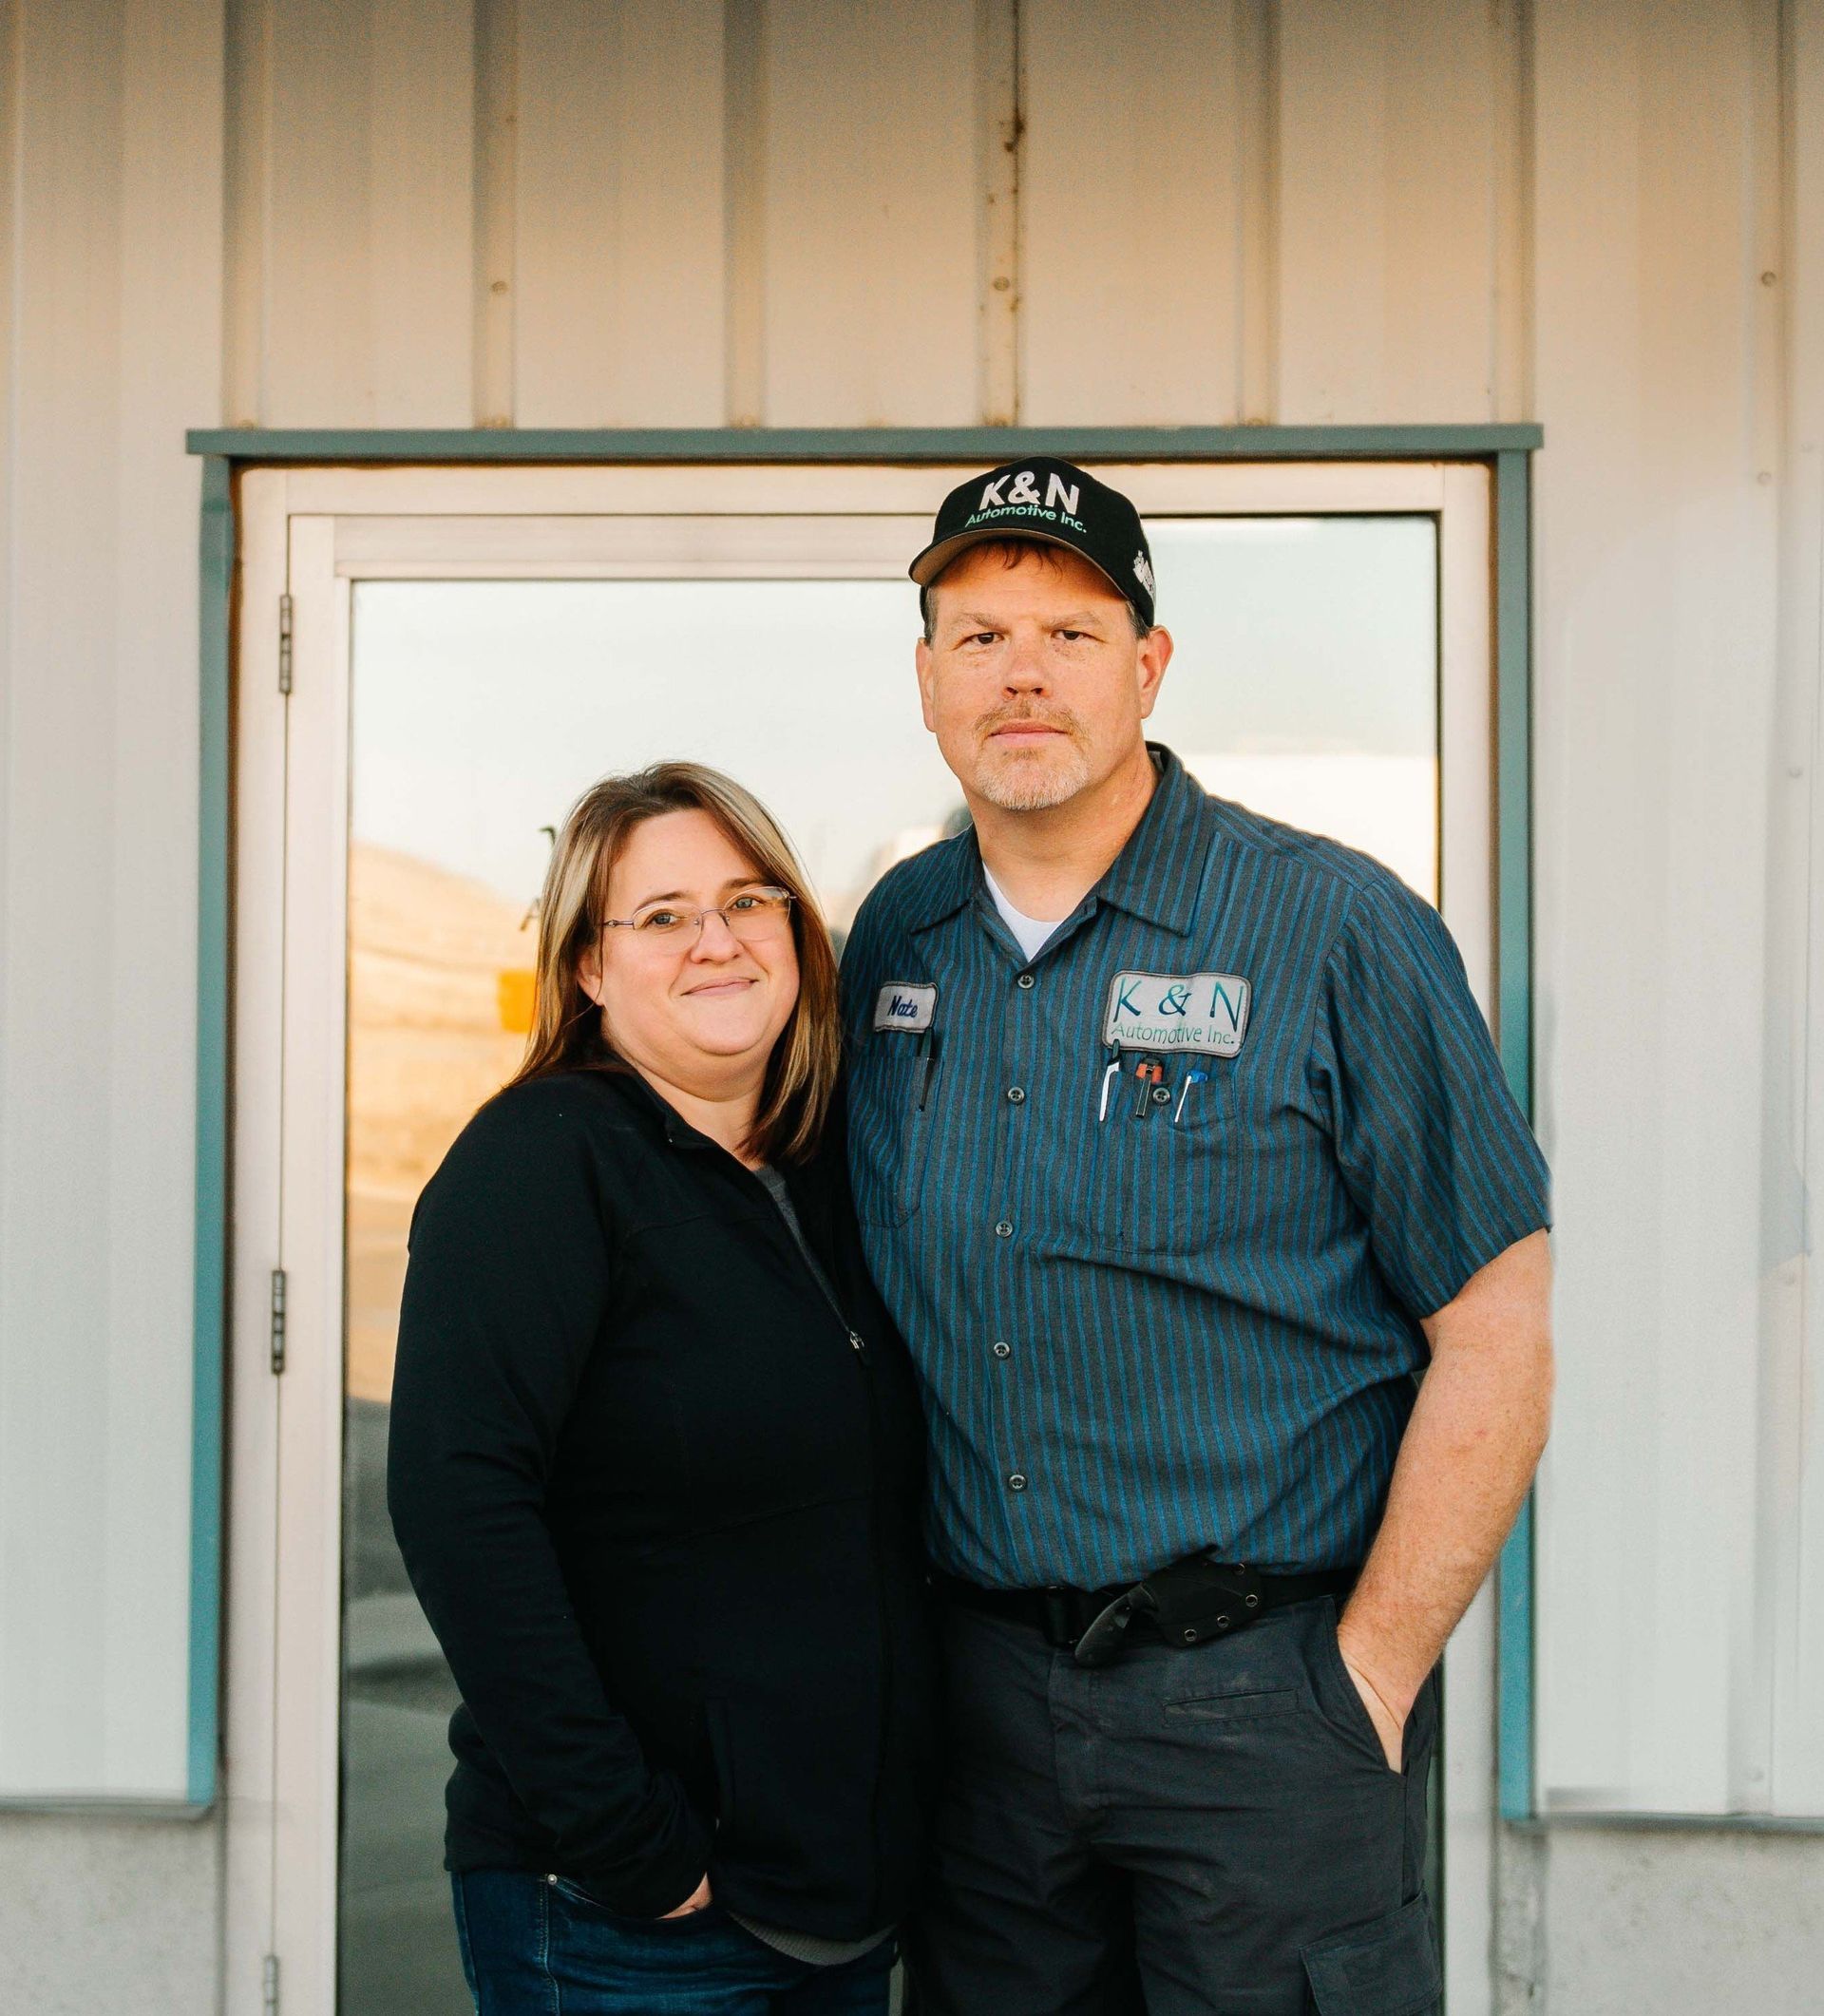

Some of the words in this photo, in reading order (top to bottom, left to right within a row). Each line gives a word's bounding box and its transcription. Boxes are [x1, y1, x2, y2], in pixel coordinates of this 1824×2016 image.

[978, 470, 1080, 515] K&N
[965, 504, 1056, 527] Automotive
[1061, 512, 1088, 534] Inc.
[887, 995, 919, 1018] Nate
[1113, 978, 1142, 1022] K
[1158, 984, 1192, 1017] &
[1209, 980, 1244, 1033] N
[1111, 1022, 1202, 1044] Automotive
[1207, 1025, 1235, 1044] Inc.
